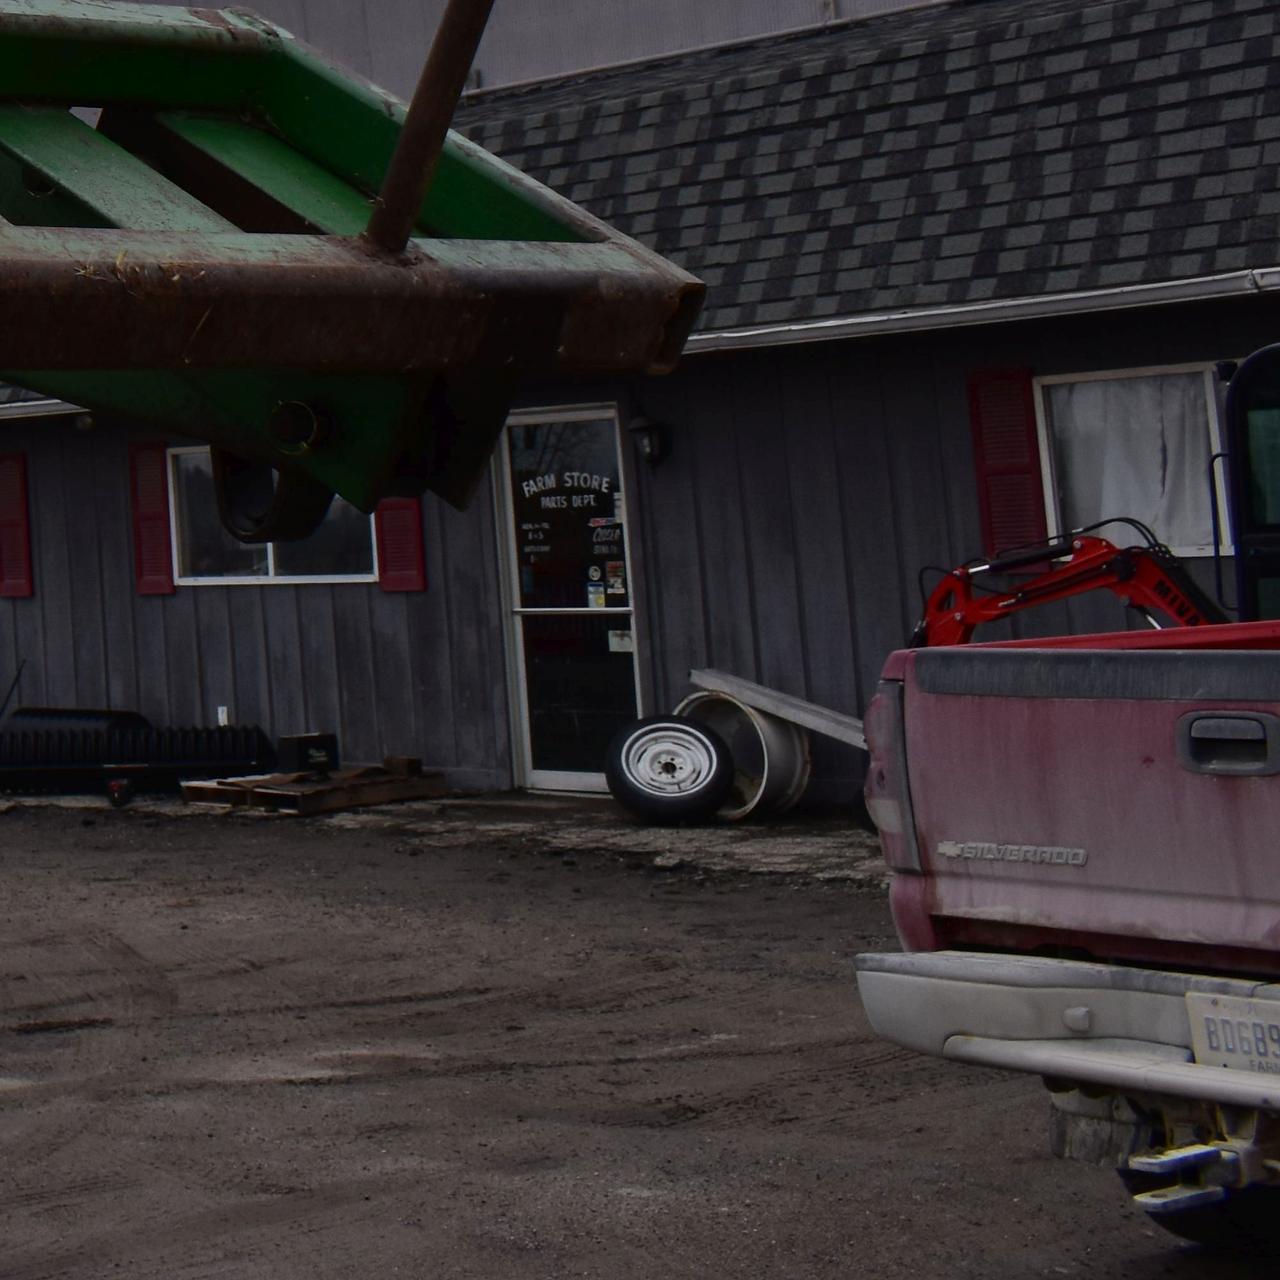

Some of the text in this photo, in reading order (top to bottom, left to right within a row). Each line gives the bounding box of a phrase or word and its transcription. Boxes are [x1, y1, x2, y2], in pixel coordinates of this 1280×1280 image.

[522, 472, 610, 497] FARM STORE
[541, 495, 567, 508] PARTS
[961, 842, 1087, 866] SILVERADO
